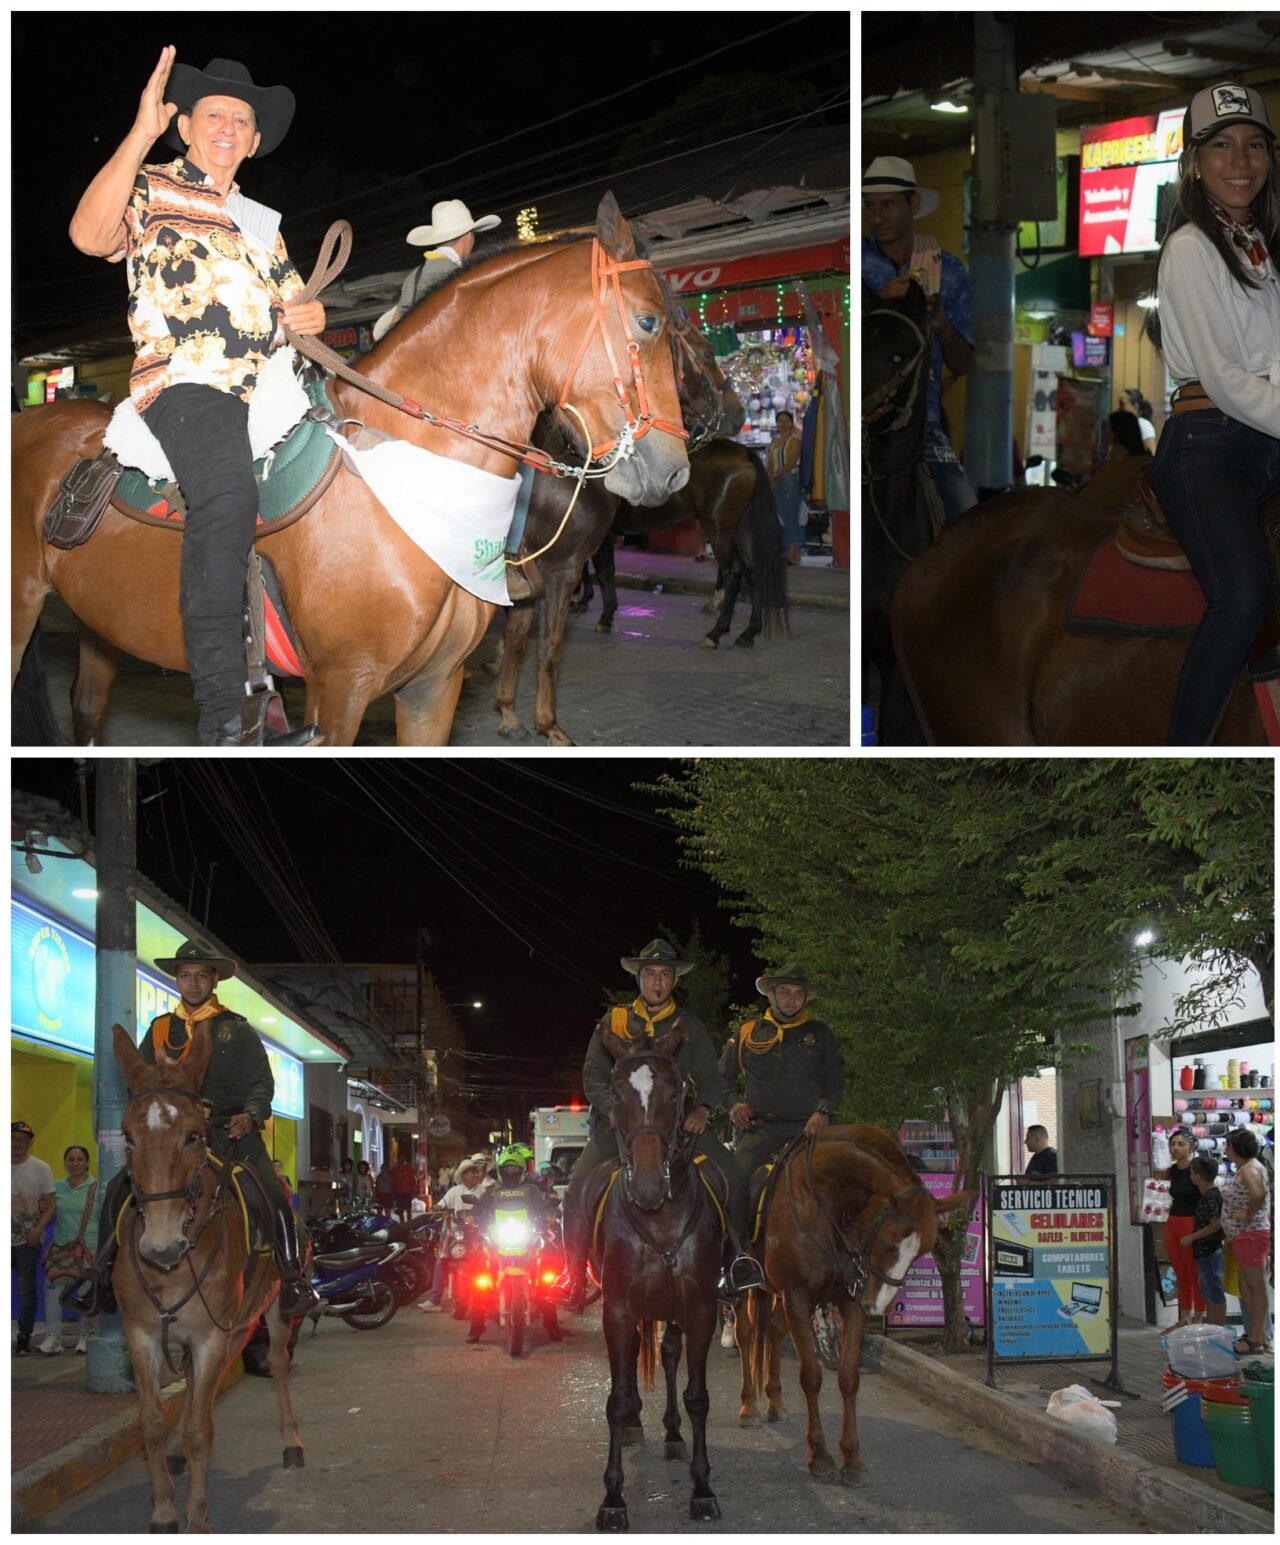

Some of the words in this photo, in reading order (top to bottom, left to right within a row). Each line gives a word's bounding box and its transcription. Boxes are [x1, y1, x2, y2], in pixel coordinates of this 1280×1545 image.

[1082, 131, 1158, 170] KAPRICELL
[668, 266, 721, 291] VO
[1001, 1190, 1052, 1209] SERVICIO
[1055, 1189, 1102, 1208] TECNICO
[1030, 1213, 1104, 1230] CELULARES
[1042, 1253, 1104, 1263] COMPUTADORES
[1056, 1264, 1090, 1274] TABLETS
